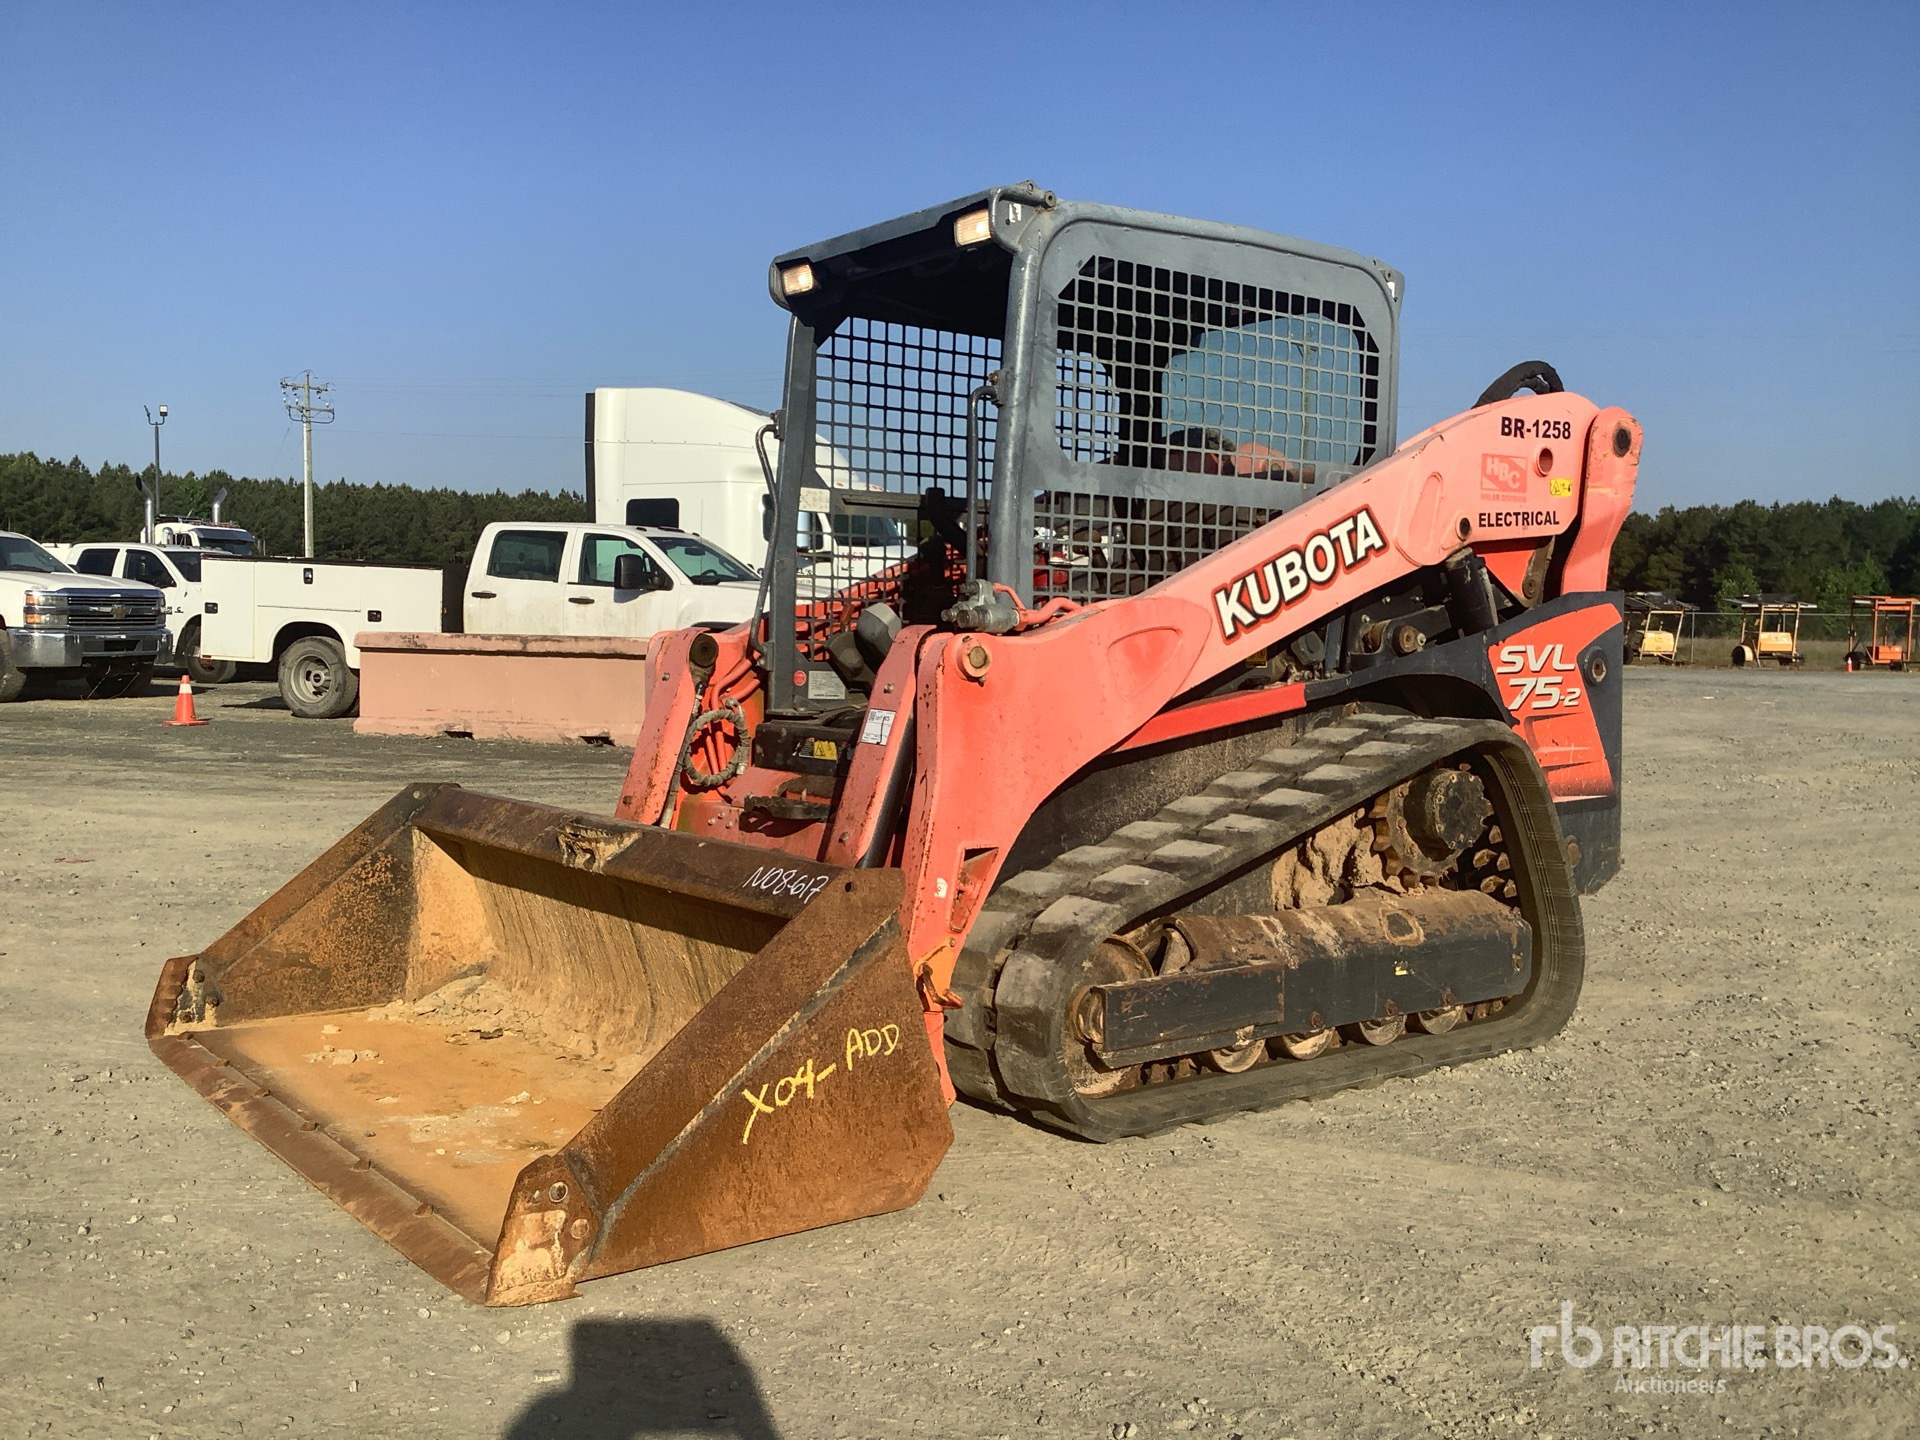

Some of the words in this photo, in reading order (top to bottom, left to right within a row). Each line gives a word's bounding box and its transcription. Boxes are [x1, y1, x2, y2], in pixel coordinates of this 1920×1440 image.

[1501, 416, 1571, 440] BR-1258
[1486, 457, 1521, 489] HBC
[1478, 510, 1560, 527] ELECTRICAL
[1213, 509, 1384, 639] KUBOTA
[1496, 643, 1576, 674] SVL
[1508, 676, 1581, 711] 75-2
[846, 1024, 899, 1071] ADD
